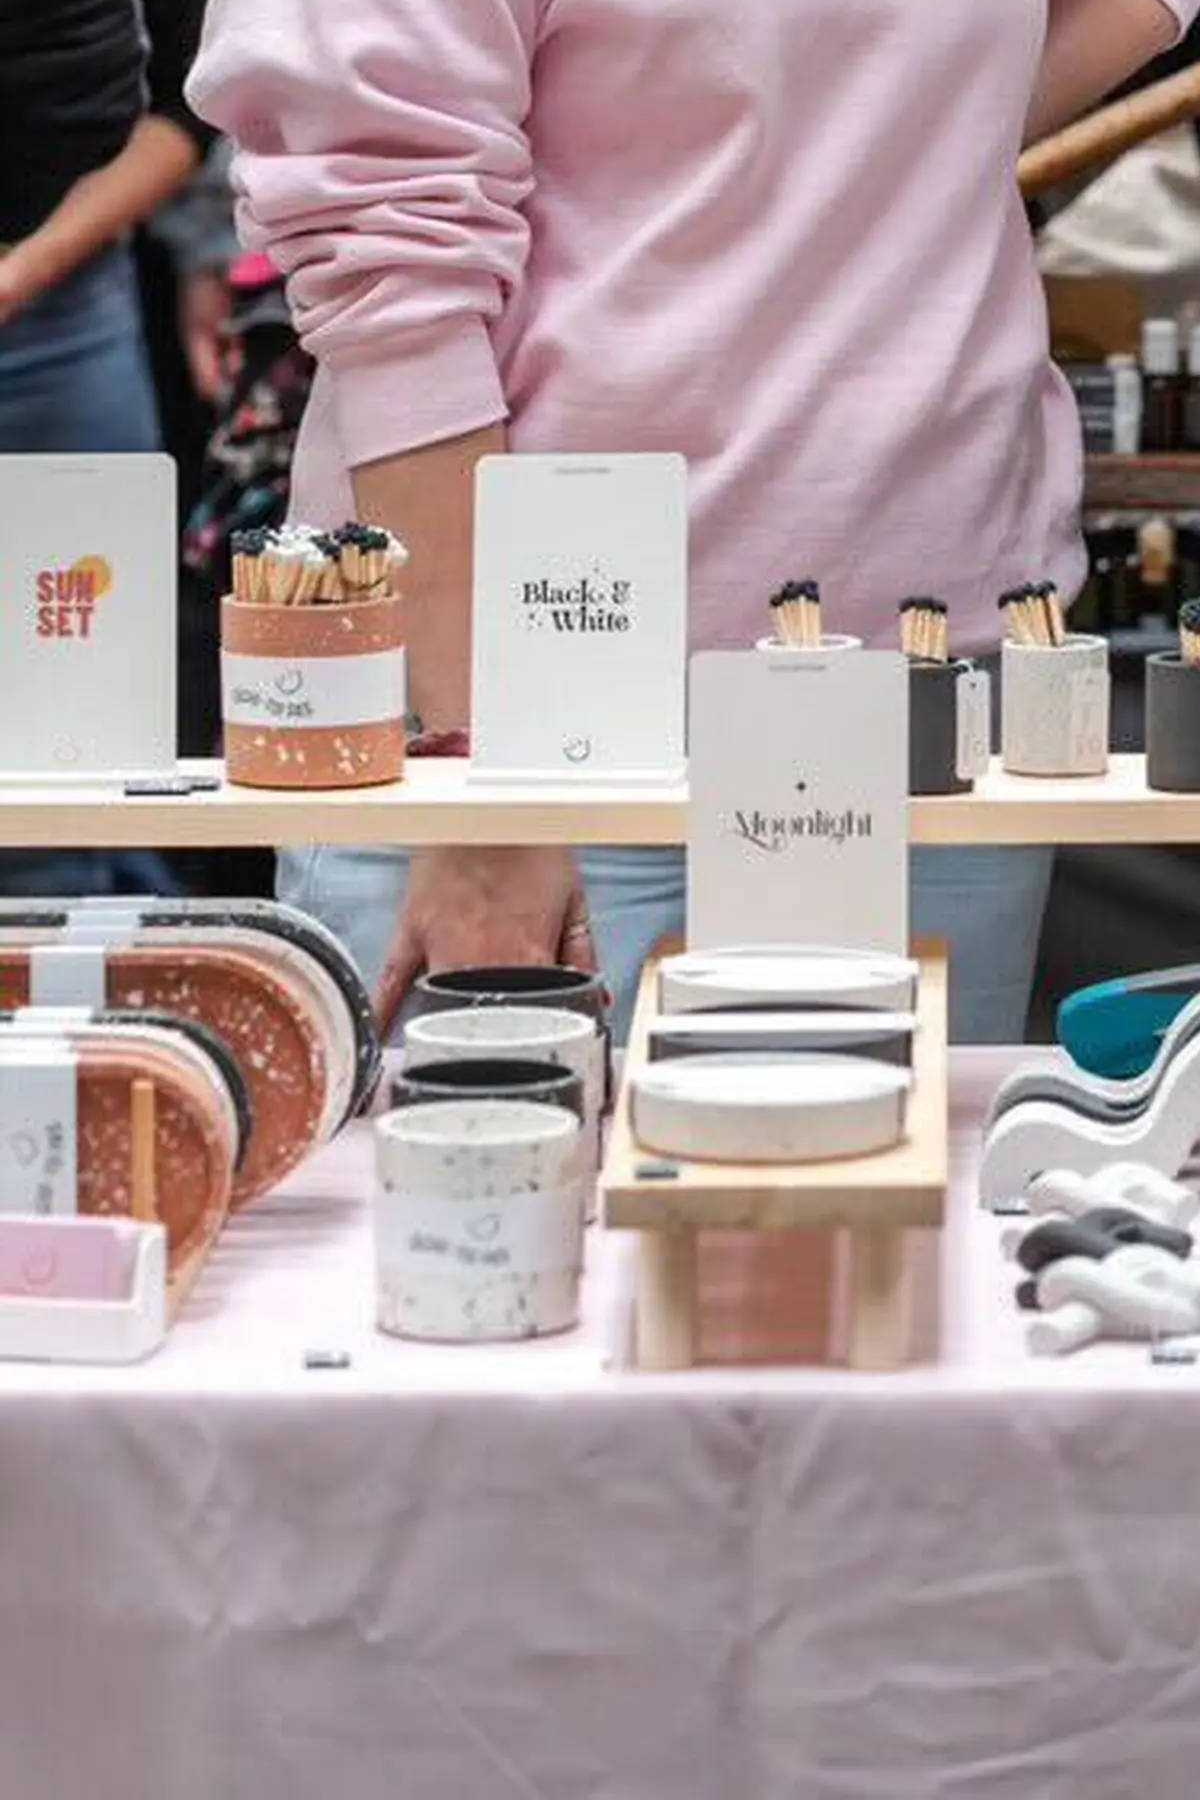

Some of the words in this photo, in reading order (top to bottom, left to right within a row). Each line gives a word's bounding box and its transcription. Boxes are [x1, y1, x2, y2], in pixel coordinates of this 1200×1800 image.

[37, 569, 95, 604] SUN
[521, 579, 604, 605] Black
[611, 580, 632, 605] &
[37, 605, 94, 638] SET
[551, 604, 630, 633] White
[733, 809, 872, 853] Moonlight
